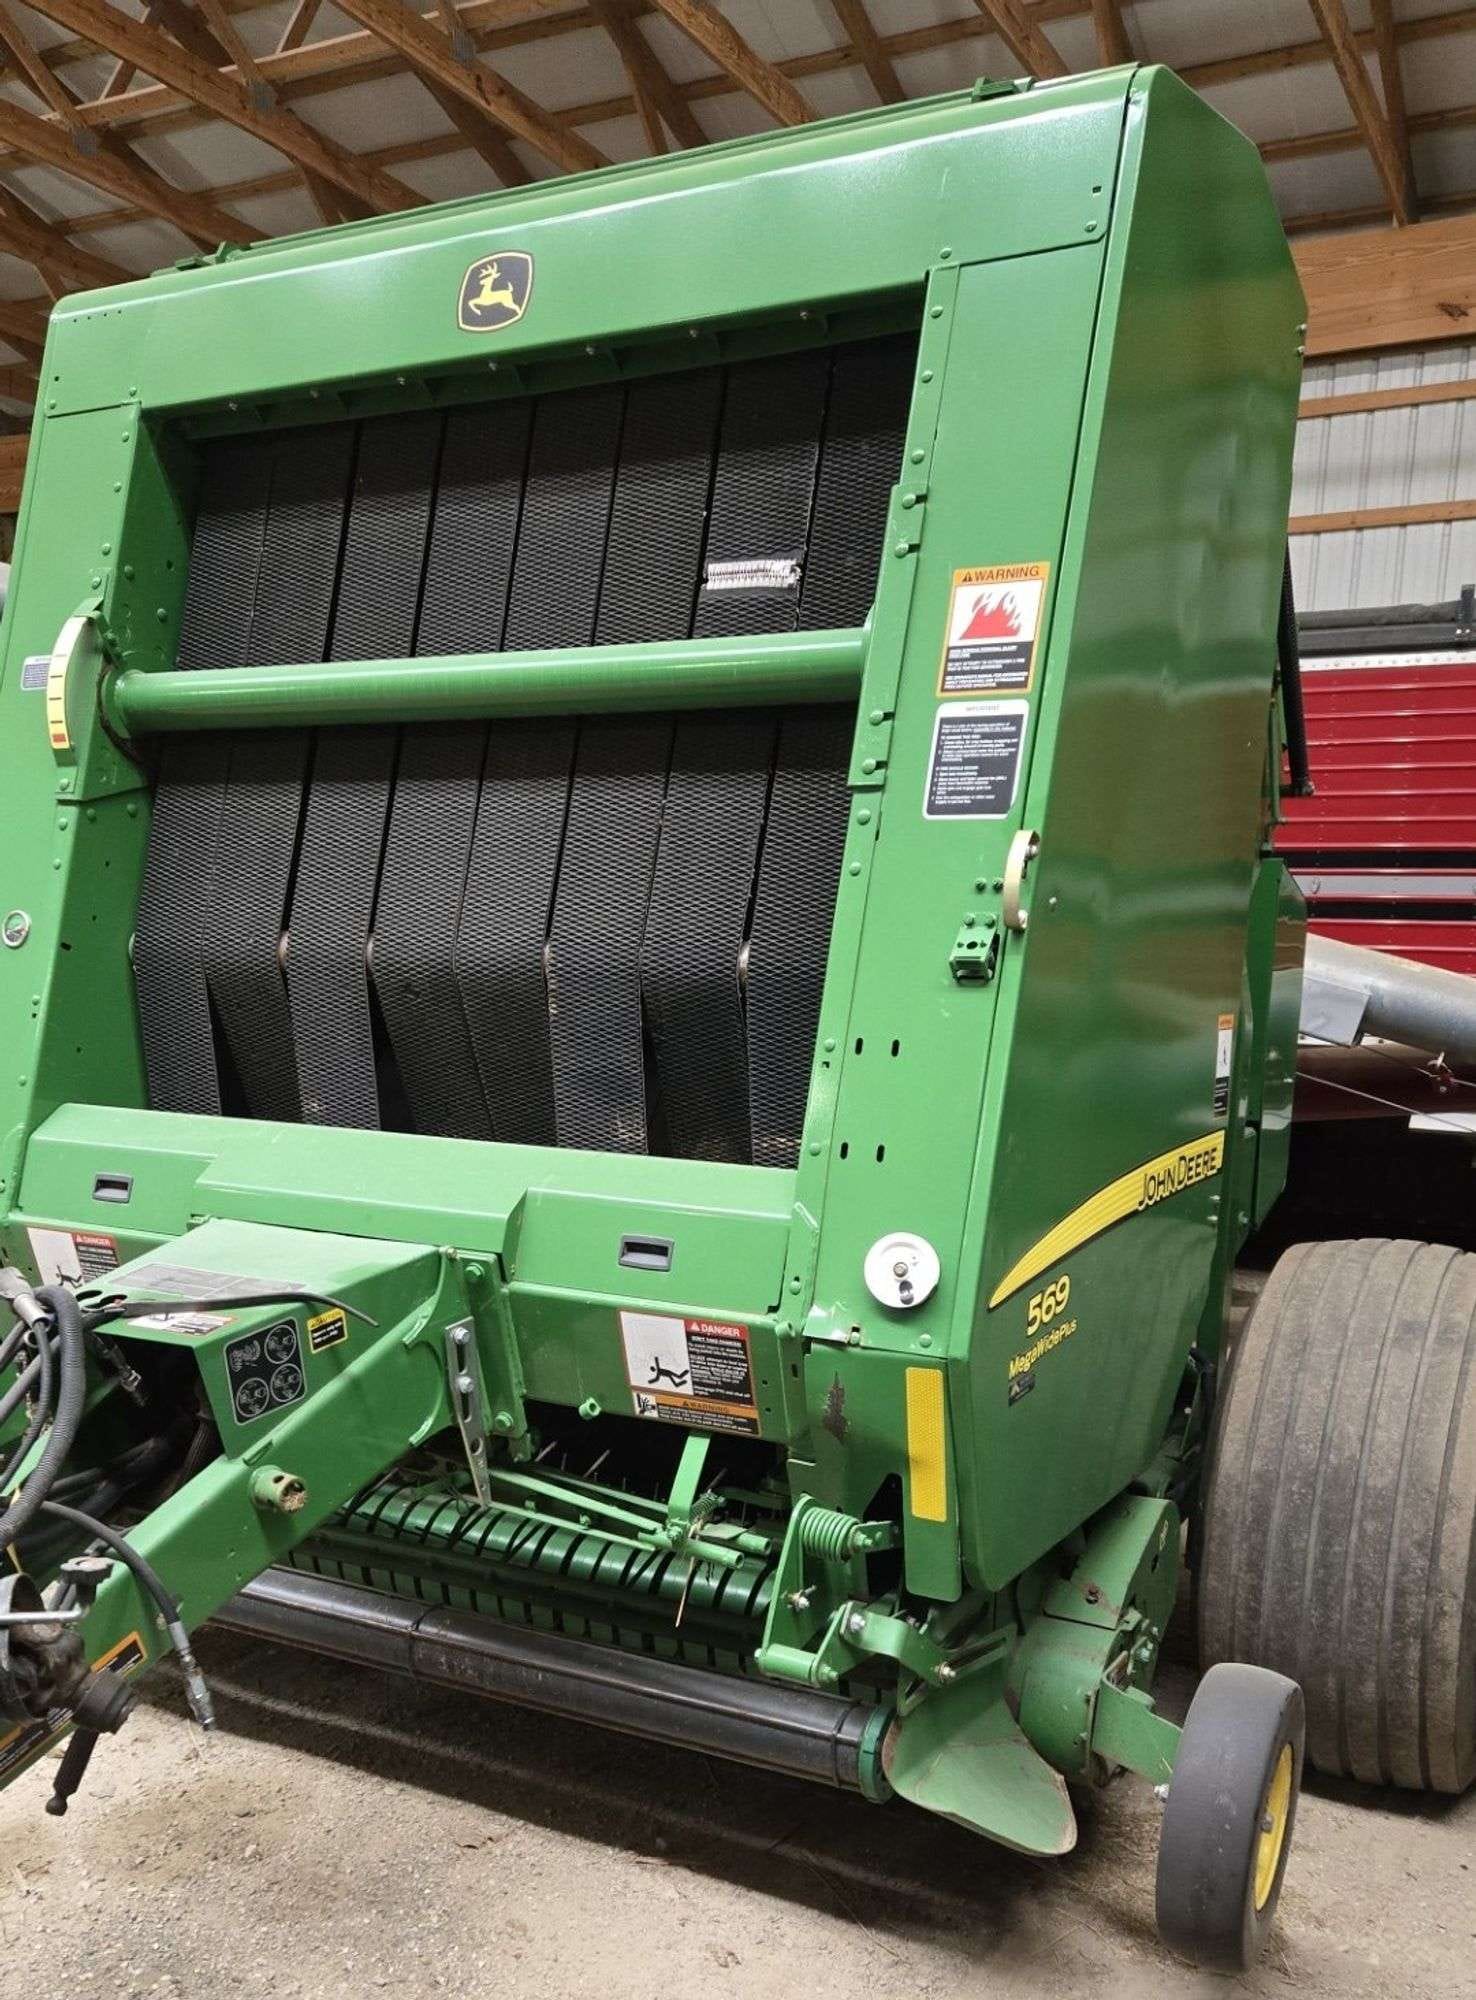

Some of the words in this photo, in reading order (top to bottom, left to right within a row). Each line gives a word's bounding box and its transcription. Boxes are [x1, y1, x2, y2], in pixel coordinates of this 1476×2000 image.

[974, 566, 1039, 581] WARNING
[1026, 1273, 1071, 1337] 569
[701, 1324, 740, 1336] DANGER
